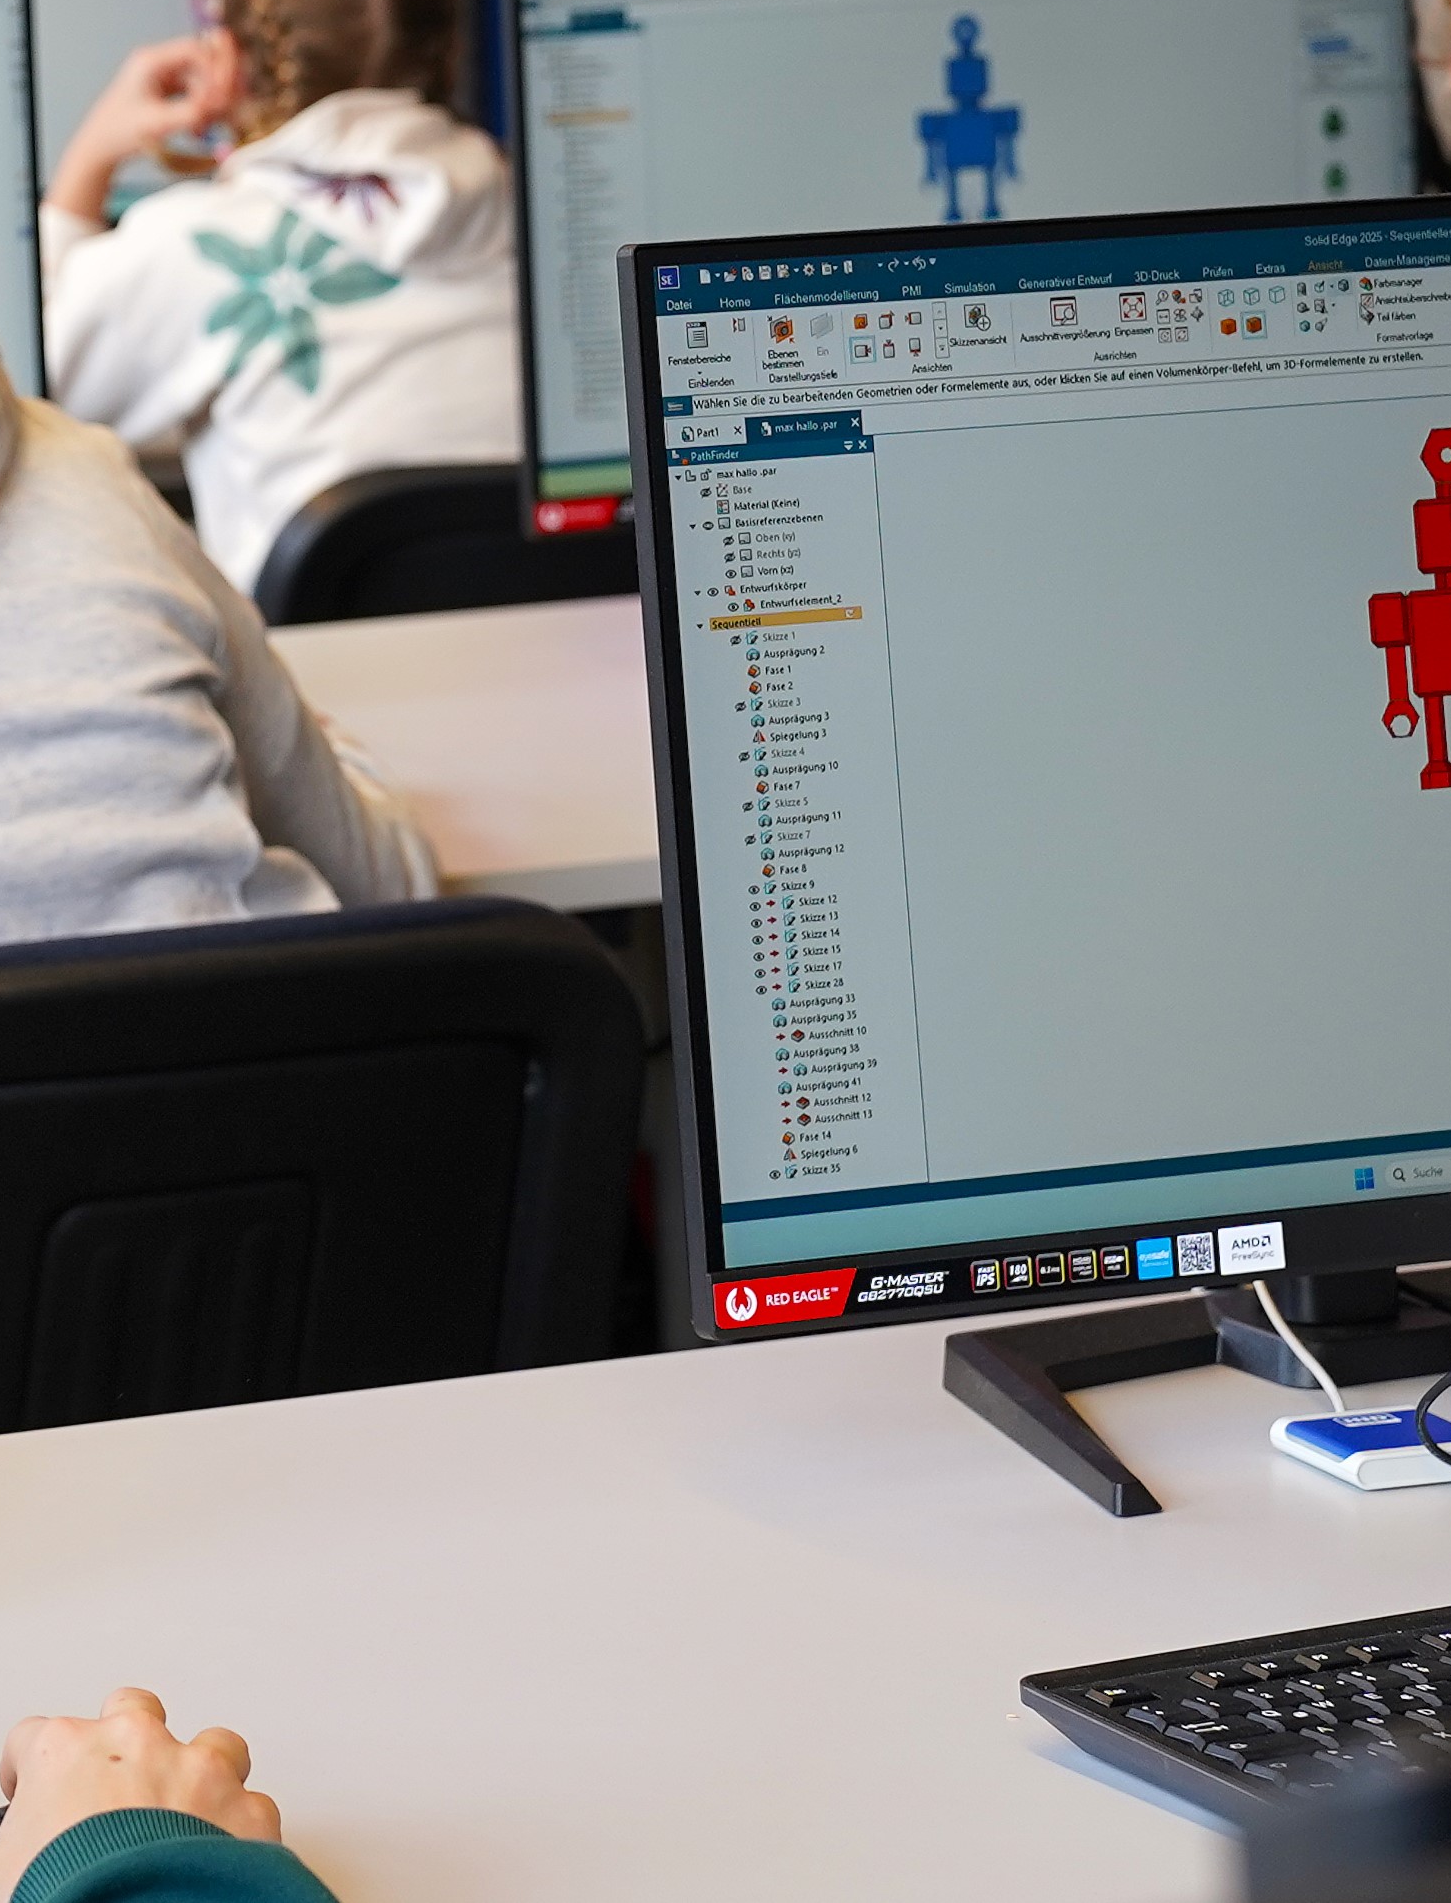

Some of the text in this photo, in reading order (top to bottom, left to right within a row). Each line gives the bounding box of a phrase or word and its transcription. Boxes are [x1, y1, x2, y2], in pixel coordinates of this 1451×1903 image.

[1202, 266, 1233, 277] Prüfen
[1255, 263, 1285, 274] Extras
[1134, 269, 1180, 282] 3D-Druck
[901, 285, 921, 296] PMI
[944, 281, 995, 293] Simulation
[719, 297, 750, 307] Home
[693, 351, 1423, 411] Wählen Sie die zu bearbeitenden Geometrien oder Formelemente aus, oder klicken Sie auf einen Volumenkörper-Befehl, um 3D-Formelemente zu erstellen.
[774, 420, 837, 432] max hallo .par
[697, 427, 719, 438] Part1
[690, 449, 739, 462] PathFinder
[734, 498, 799, 510] Material (Keine)
[739, 581, 806, 593] Entwurfskörper
[1231, 1237, 1263, 1249] AMD
[1009, 1263, 1027, 1277] 180
[976, 1272, 995, 1287] IPS
[857, 1283, 943, 1302] GB2770QSU
[765, 1292, 790, 1306] RED
